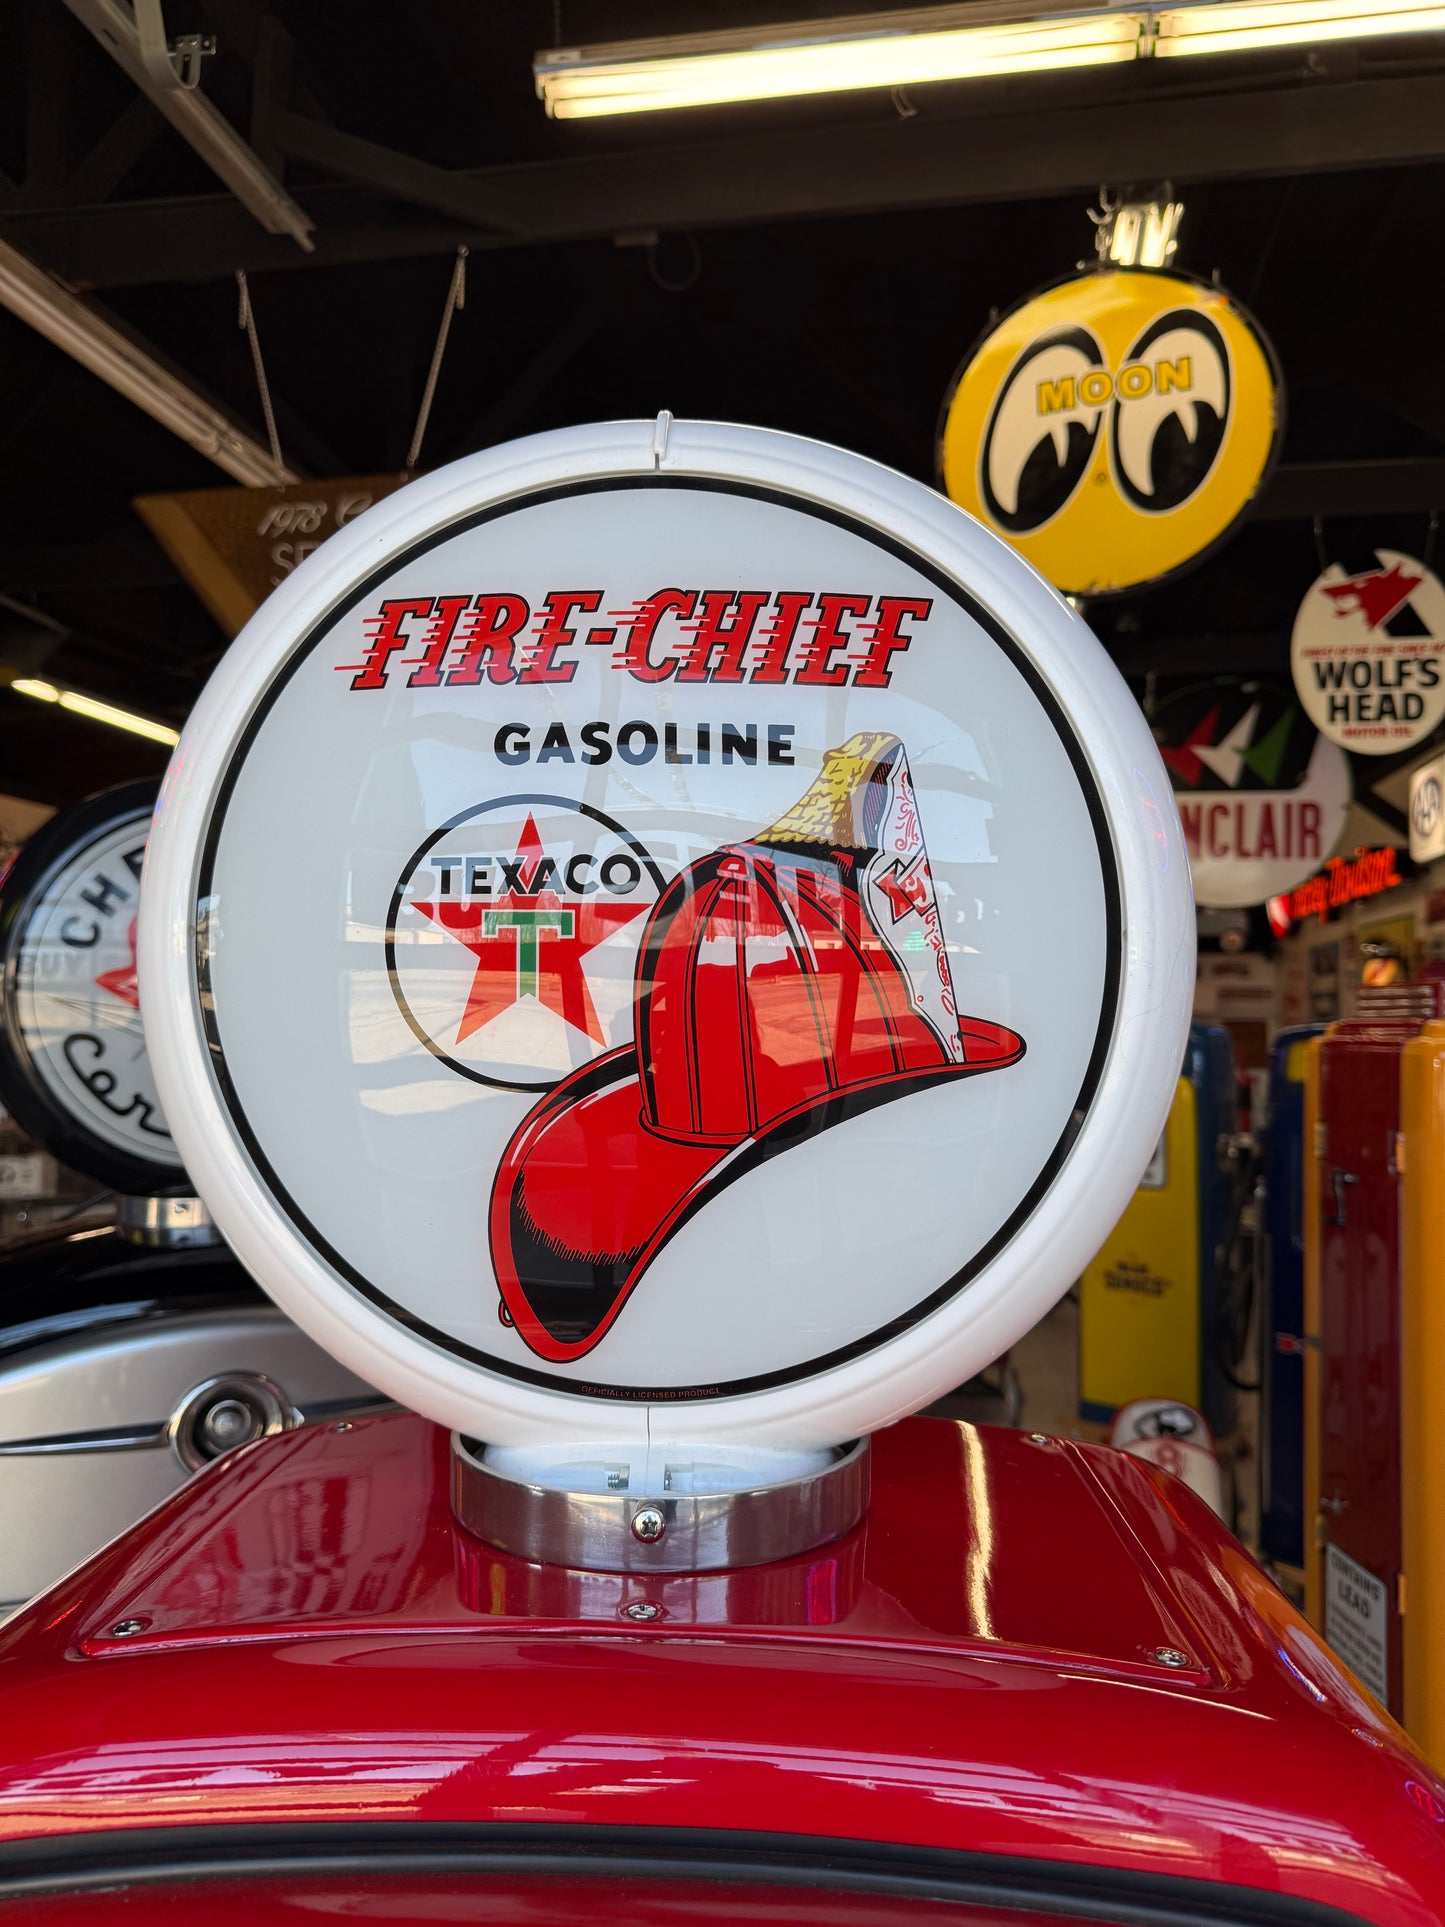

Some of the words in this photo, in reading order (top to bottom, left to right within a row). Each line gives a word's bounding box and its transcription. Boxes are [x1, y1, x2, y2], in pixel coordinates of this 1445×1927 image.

[1037, 356, 1192, 414] MOON
[257, 500, 329, 538] 1978
[334, 588, 933, 691] FIRE-CHIEF
[1313, 657, 1441, 690] WOLF'S
[1328, 692, 1425, 723] HEAD
[494, 720, 796, 767] GASOLINE
[1181, 801, 1323, 859] NCLAIR
[431, 853, 641, 896] TEXACO
[482, 909, 575, 998] T
[580, 1385, 631, 1398] OFFICIALLY
[632, 1390, 676, 1399] LICENSED
[678, 1387, 720, 1398] PRODUCT
[1337, 1580, 1371, 1618] LEAD
